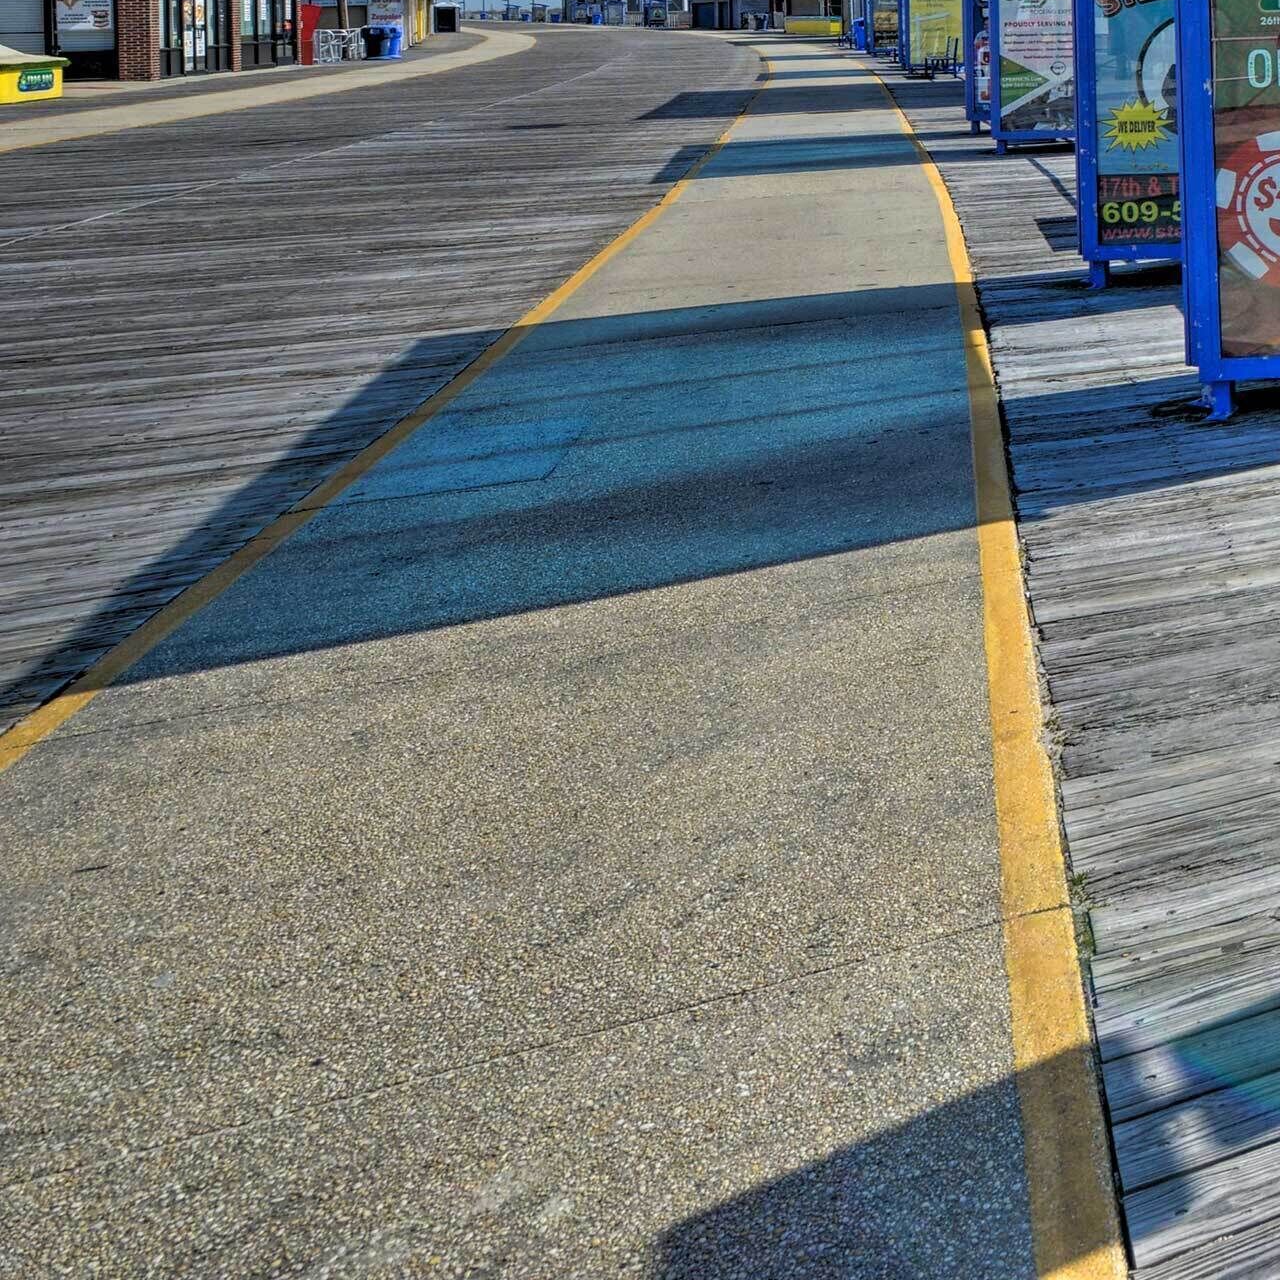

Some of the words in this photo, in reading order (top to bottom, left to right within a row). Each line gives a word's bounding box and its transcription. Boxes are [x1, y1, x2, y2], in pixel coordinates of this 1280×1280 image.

[1118, 121, 1128, 133] WE
[1129, 120, 1156, 133] DELIVER
[1100, 177, 1140, 198] 17th
[1148, 176, 1163, 197] &
